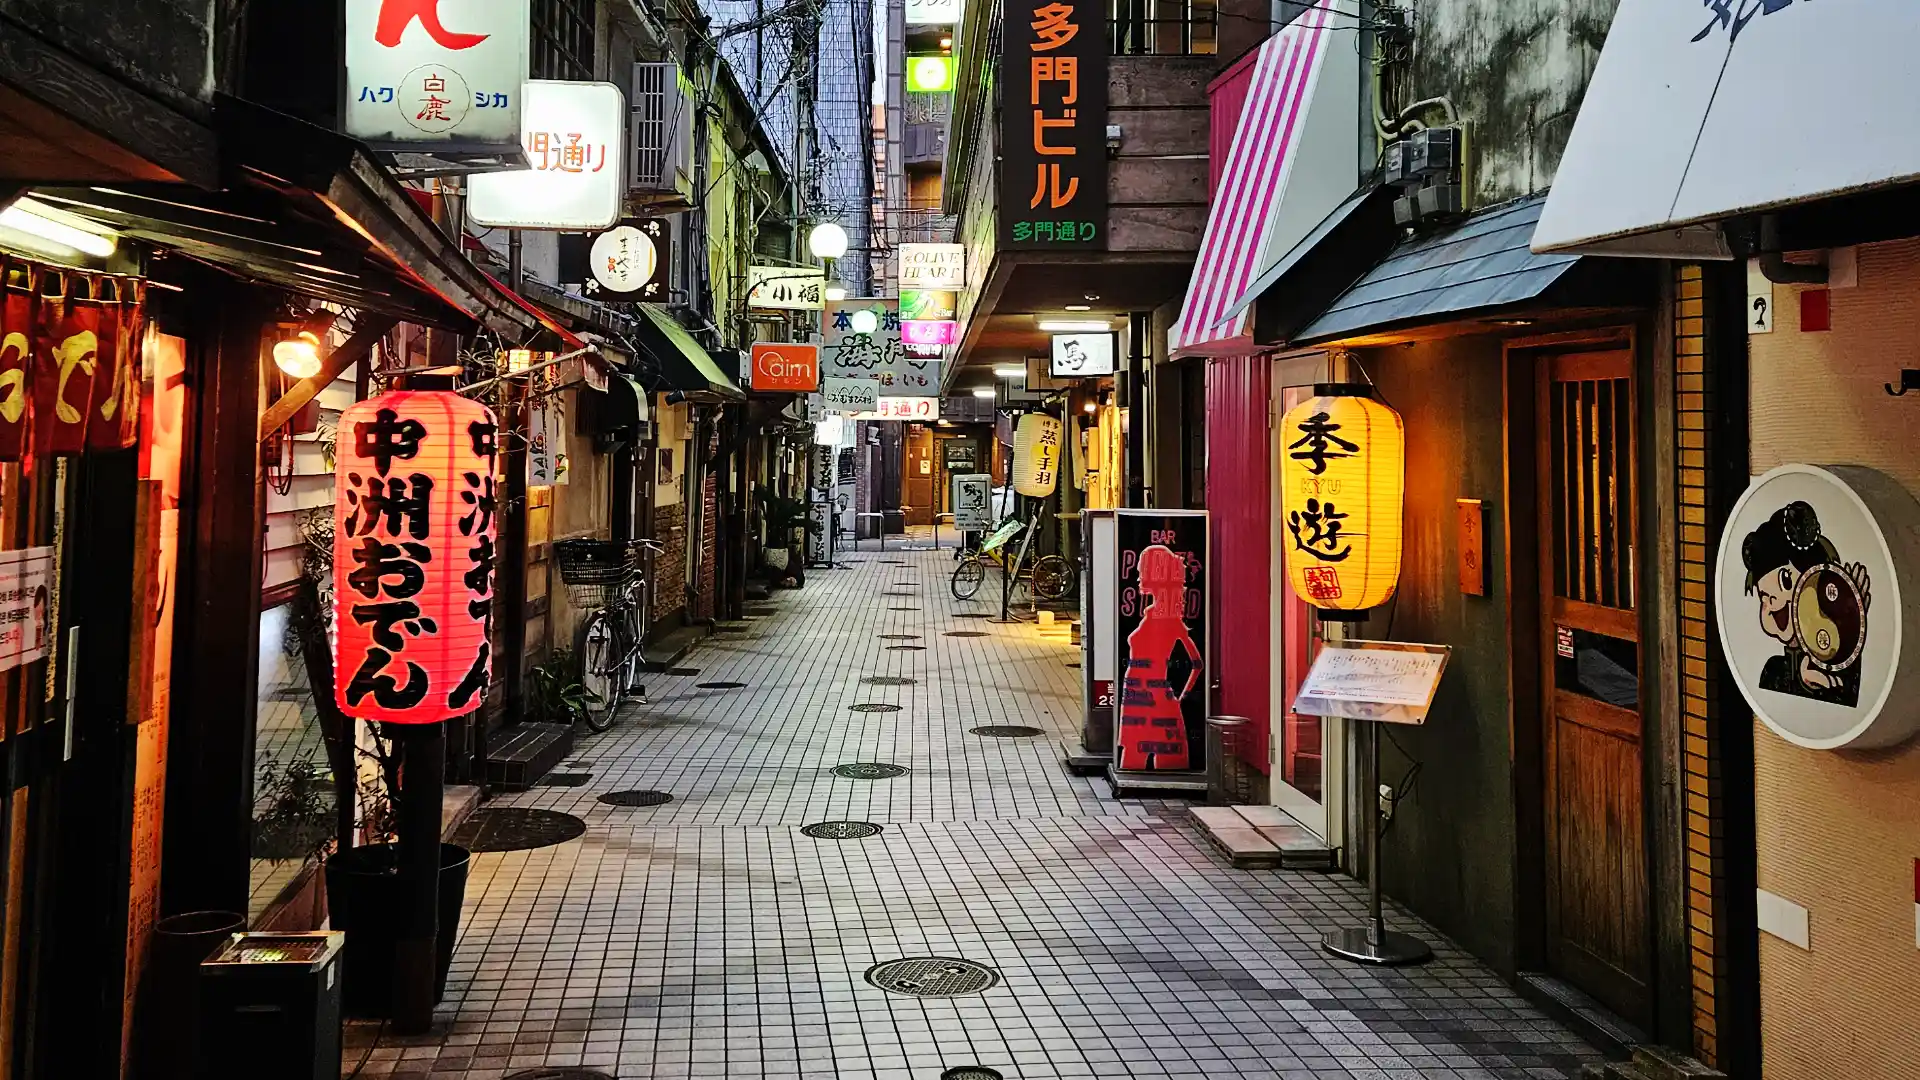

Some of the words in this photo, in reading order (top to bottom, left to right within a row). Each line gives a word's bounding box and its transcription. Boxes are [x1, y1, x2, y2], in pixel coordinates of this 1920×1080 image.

[358, 86, 394, 103] ハク
[416, 73, 451, 121] 白鹿
[475, 92, 508, 108] シカ
[1030, 2, 1079, 210] 多門ビル
[1012, 221, 1096, 242] 多門通り
[913, 251, 960, 264] OLIVE
[772, 283, 820, 304] 小福
[1057, 340, 1088, 371] 馬
[1035, 429, 1058, 484] 蒸し手羽
[1300, 478, 1341, 495] KYU
[1150, 530, 1176, 544] BAR
[344, 408, 437, 709] 中洲おでん
